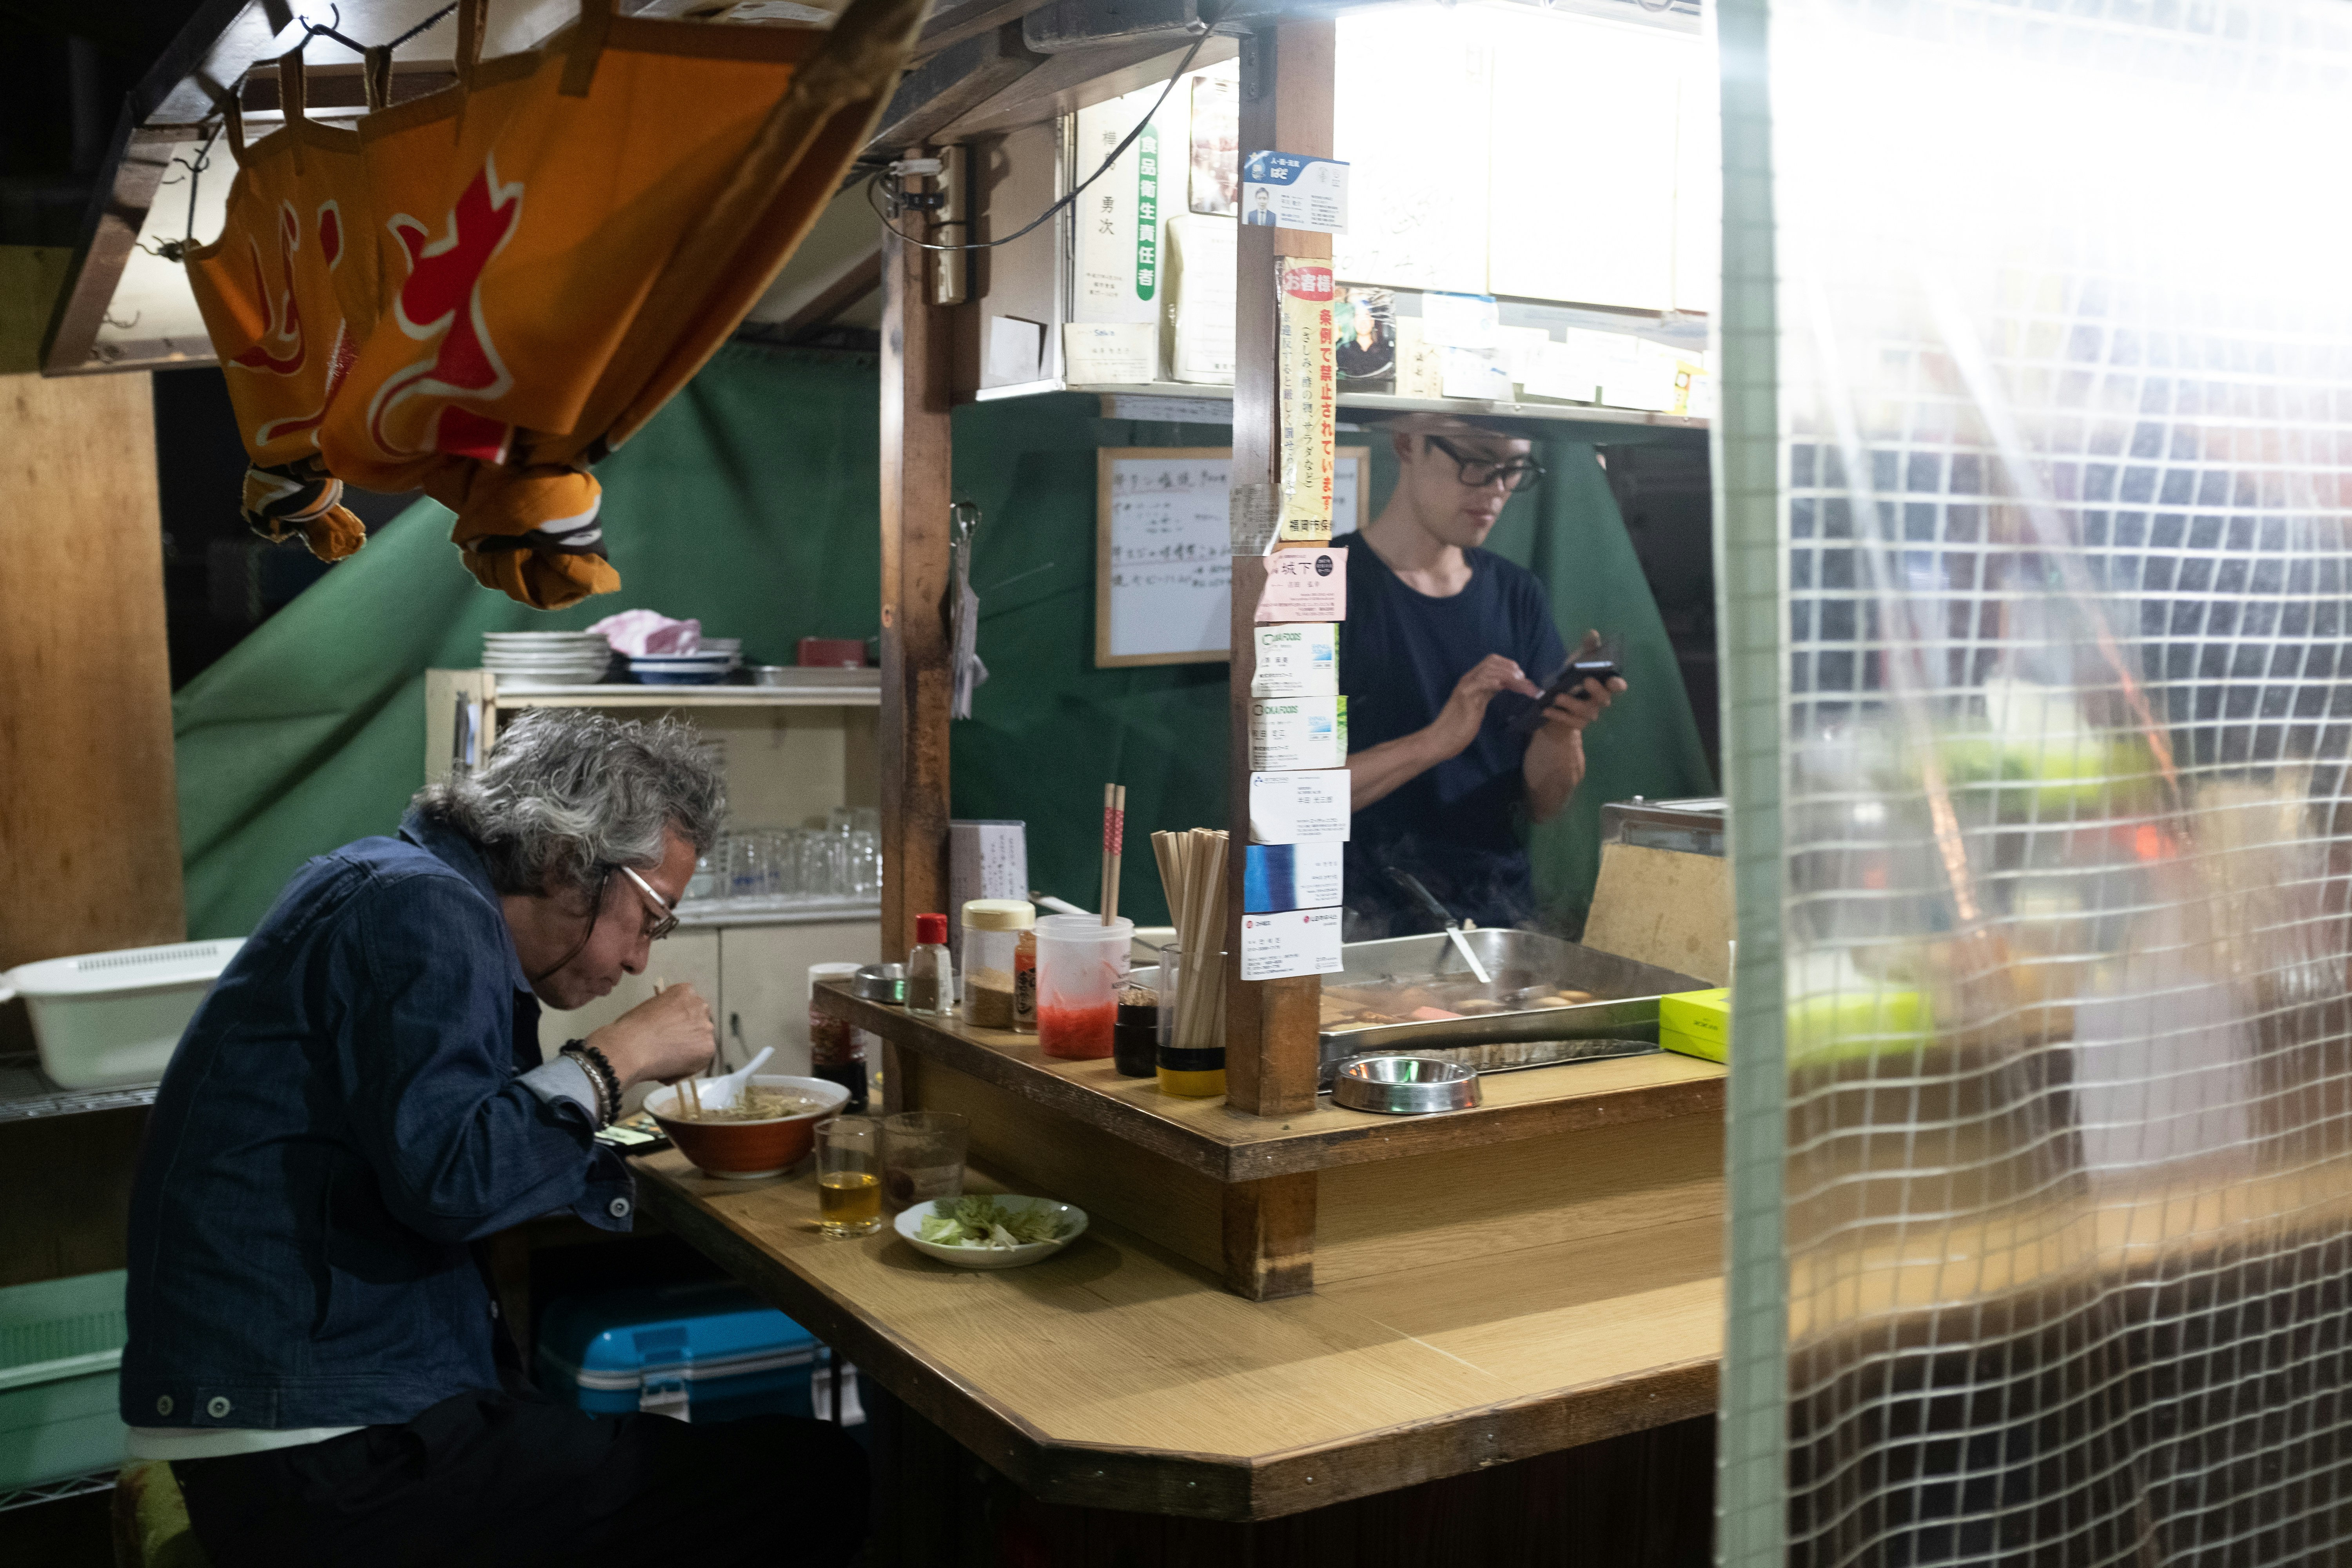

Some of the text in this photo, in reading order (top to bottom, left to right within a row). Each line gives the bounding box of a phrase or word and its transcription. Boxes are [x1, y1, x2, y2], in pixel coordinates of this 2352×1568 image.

[1098, 196, 1115, 235] 勇次
[1138, 136, 1157, 287] 食品衛生責任者
[1284, 273, 1331, 293] お客様
[1319, 309, 1333, 511] 条例で禁止されています
